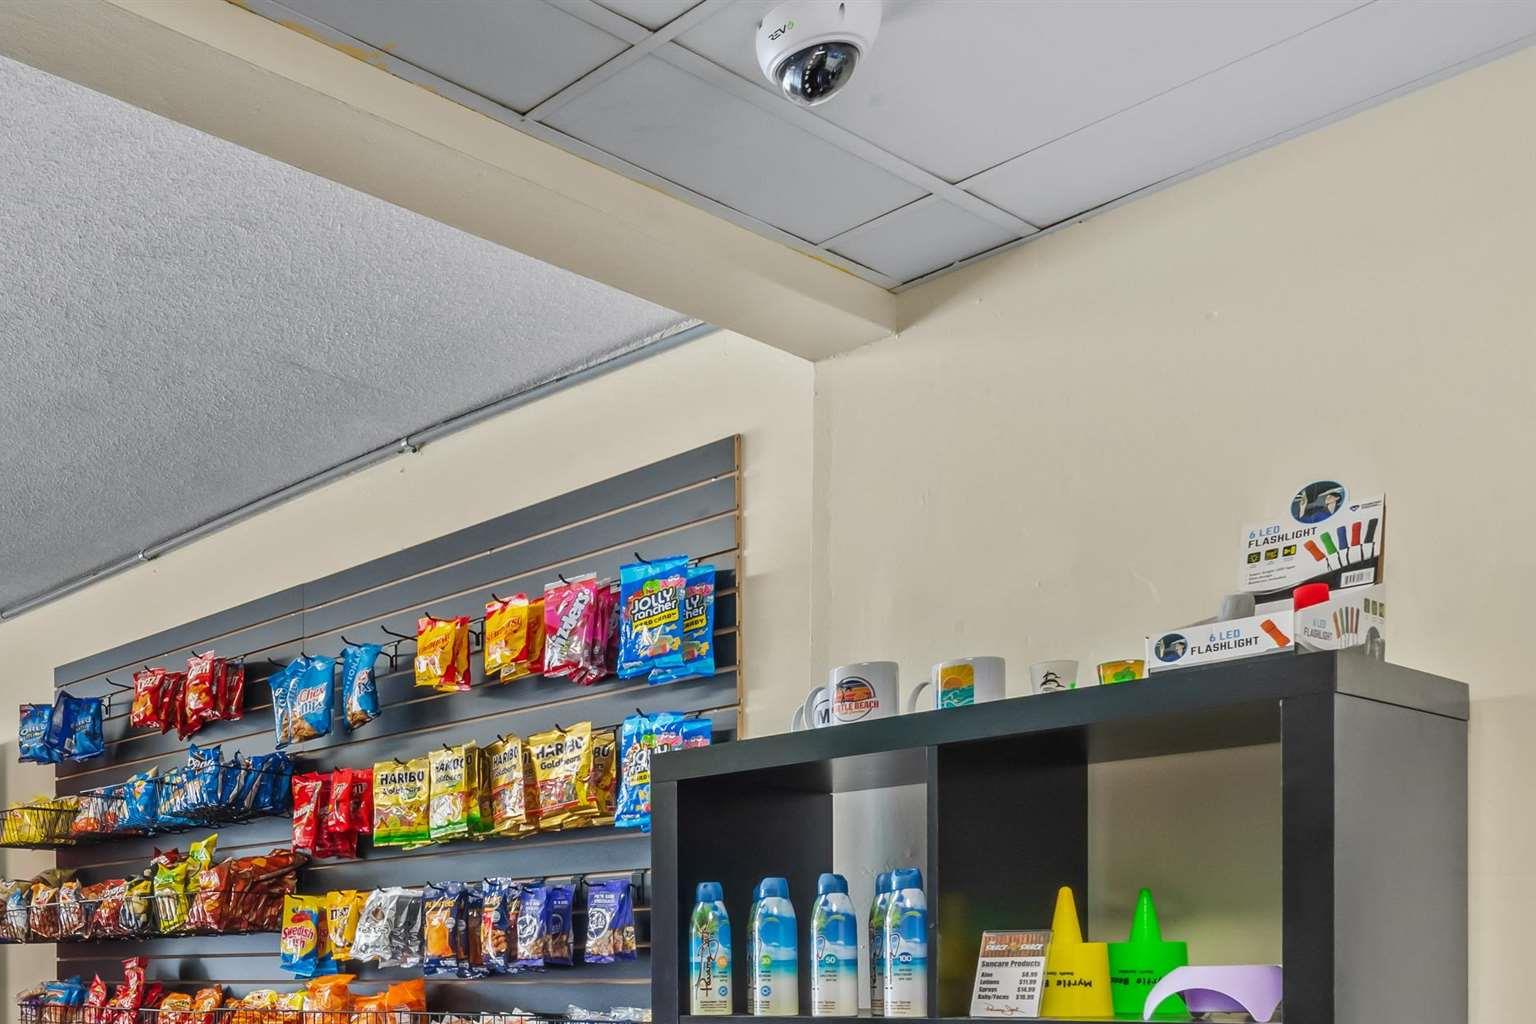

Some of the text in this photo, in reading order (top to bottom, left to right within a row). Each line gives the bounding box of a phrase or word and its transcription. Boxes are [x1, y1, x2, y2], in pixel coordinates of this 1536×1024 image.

[1248, 527, 1317, 548] FLASHLIGHT
[1259, 525, 1281, 538] LED
[632, 587, 675, 614] JOLLY
[634, 599, 677, 622] rancher
[1209, 629, 1241, 643] 6 LED
[1190, 636, 1260, 655] FLASHLIGHT
[855, 700, 879, 710] BEACH
[536, 736, 584, 760] HARIBO
[381, 771, 425, 786] HARIBO
[283, 926, 314, 940] Swedish
[826, 956, 835, 964] 50
[981, 960, 1040, 968] Suncare Products
[1056, 978, 1092, 988] Myrtle
